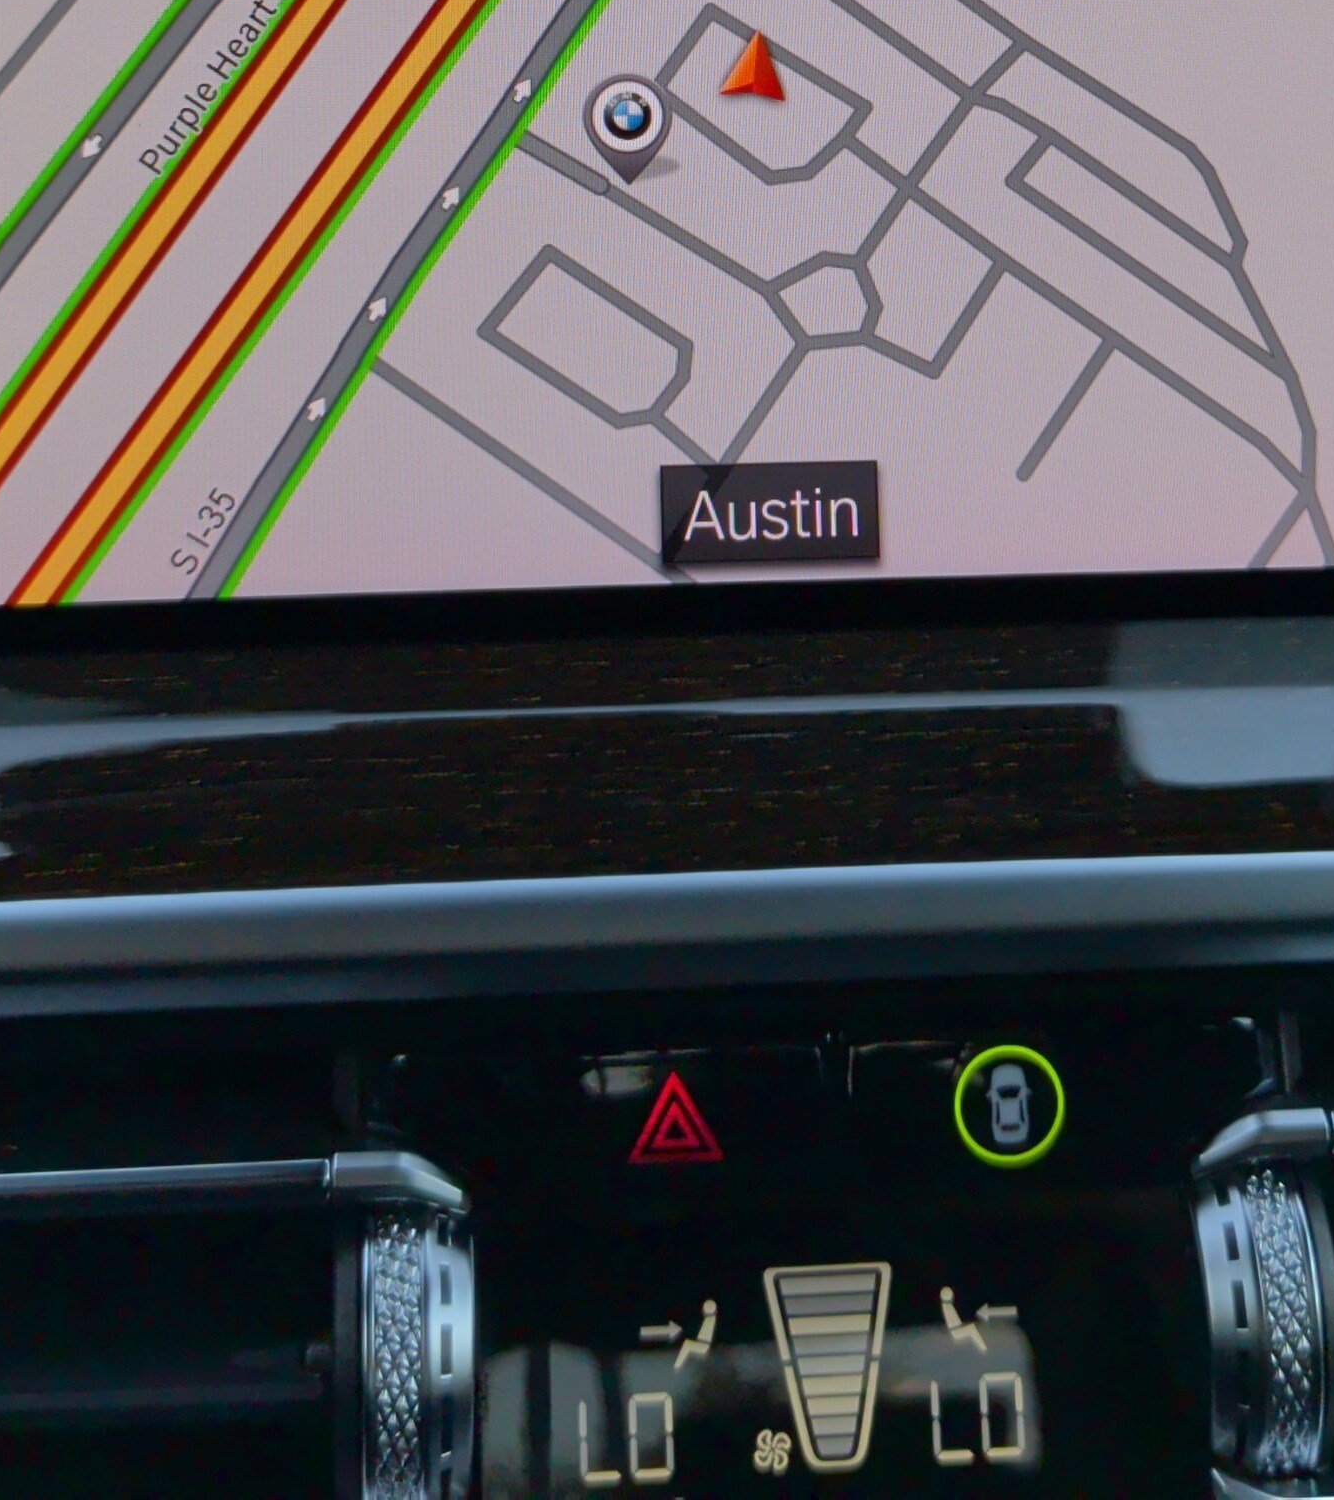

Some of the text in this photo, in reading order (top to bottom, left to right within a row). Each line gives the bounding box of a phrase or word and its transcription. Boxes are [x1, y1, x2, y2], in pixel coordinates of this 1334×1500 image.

[138, 82, 218, 175] Purple
[683, 487, 861, 542] Austin
[170, 547, 200, 575] S
